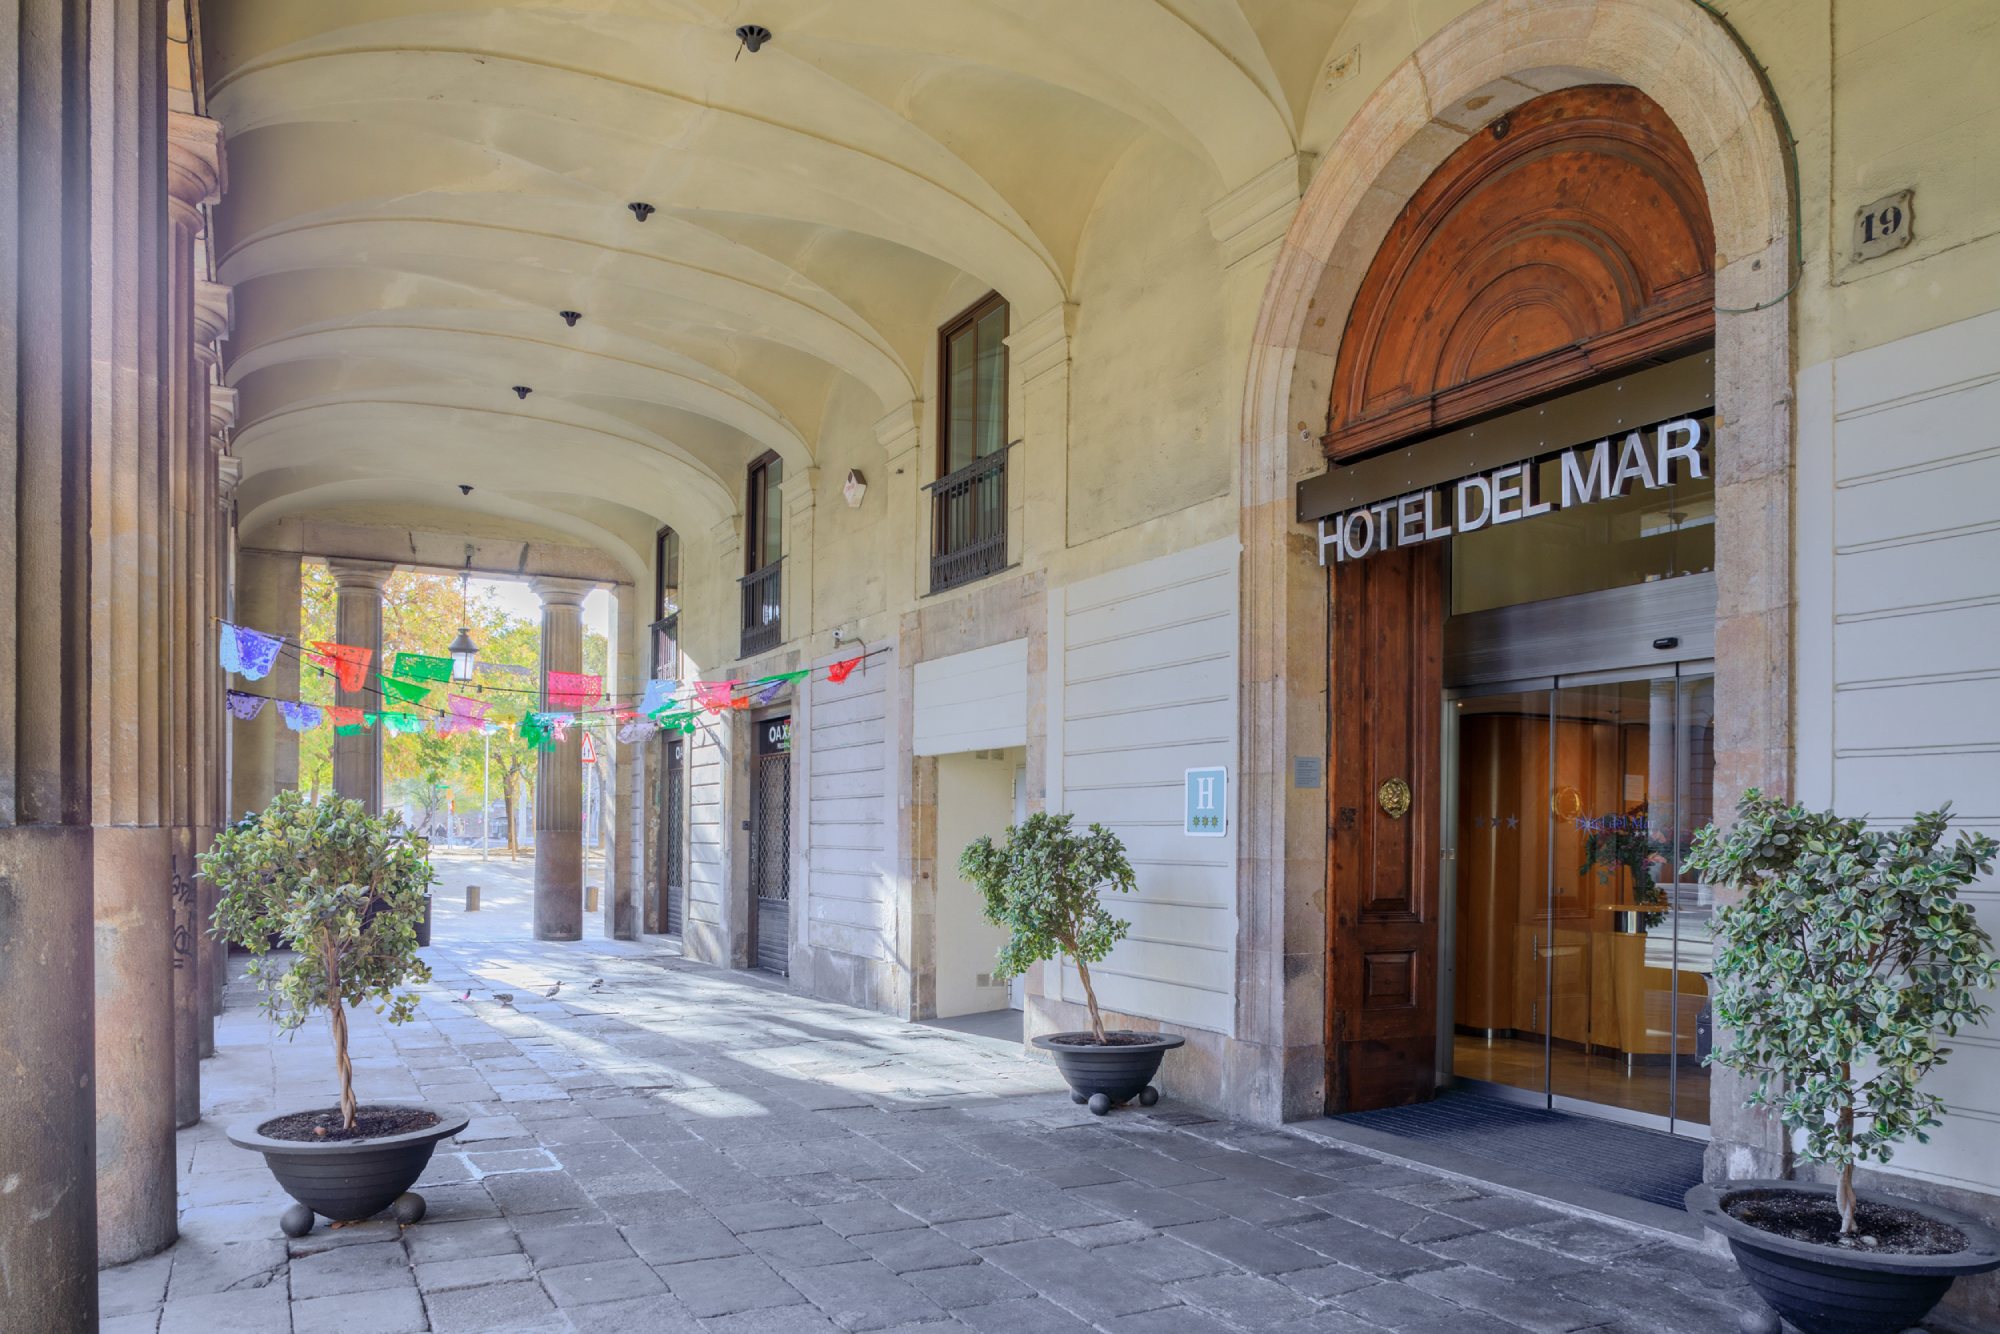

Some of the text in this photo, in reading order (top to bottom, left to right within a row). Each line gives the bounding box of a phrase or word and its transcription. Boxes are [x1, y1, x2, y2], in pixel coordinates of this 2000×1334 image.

[1861, 206, 1902, 244] 19
[1318, 418, 1704, 566] HOTEL DEL MAR
[1196, 776, 1215, 810] H
[1575, 815, 1605, 829] Hel
